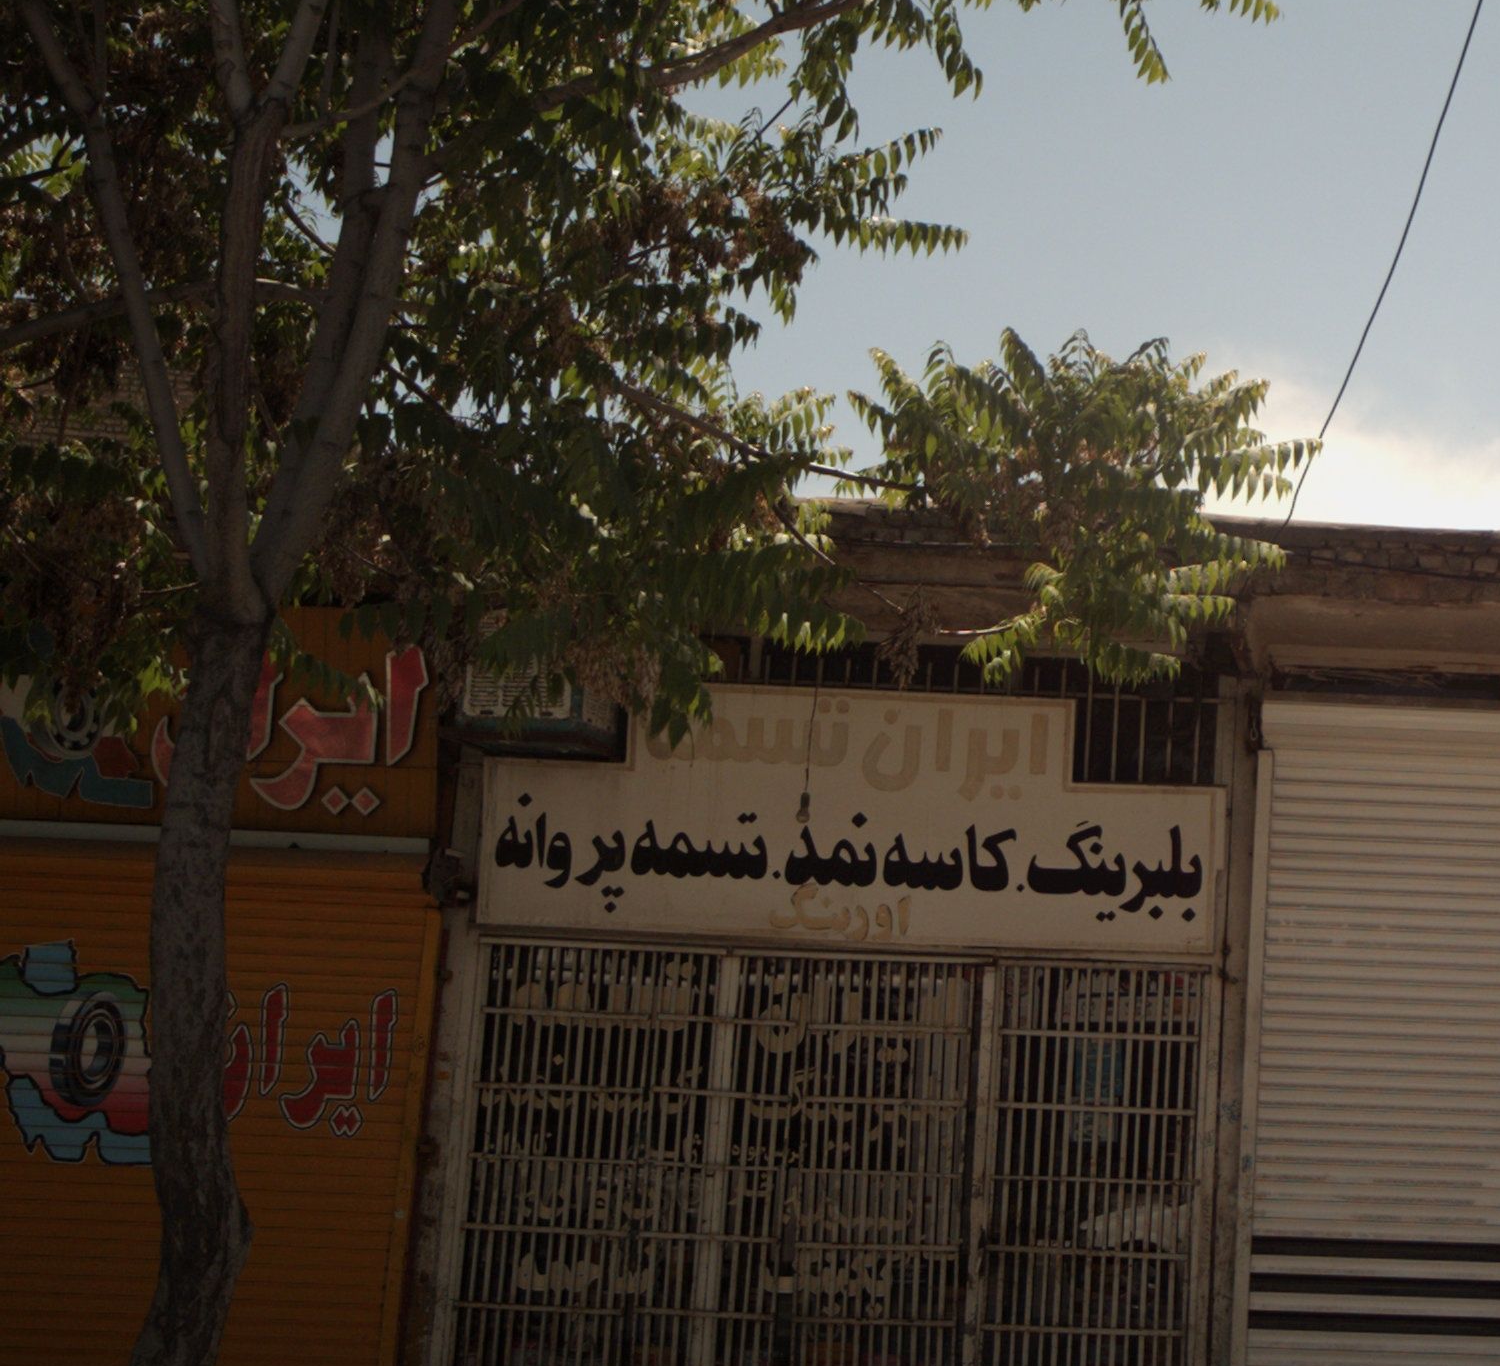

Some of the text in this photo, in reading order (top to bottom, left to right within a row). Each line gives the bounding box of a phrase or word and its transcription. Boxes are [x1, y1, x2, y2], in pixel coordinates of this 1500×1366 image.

[151, 643, 429, 815] ایرا
[862, 707, 1049, 803] ایران
[495, 792, 626, 914] پروانه
[631, 812, 768, 880] تسمه
[884, 823, 1016, 891] کاسه
